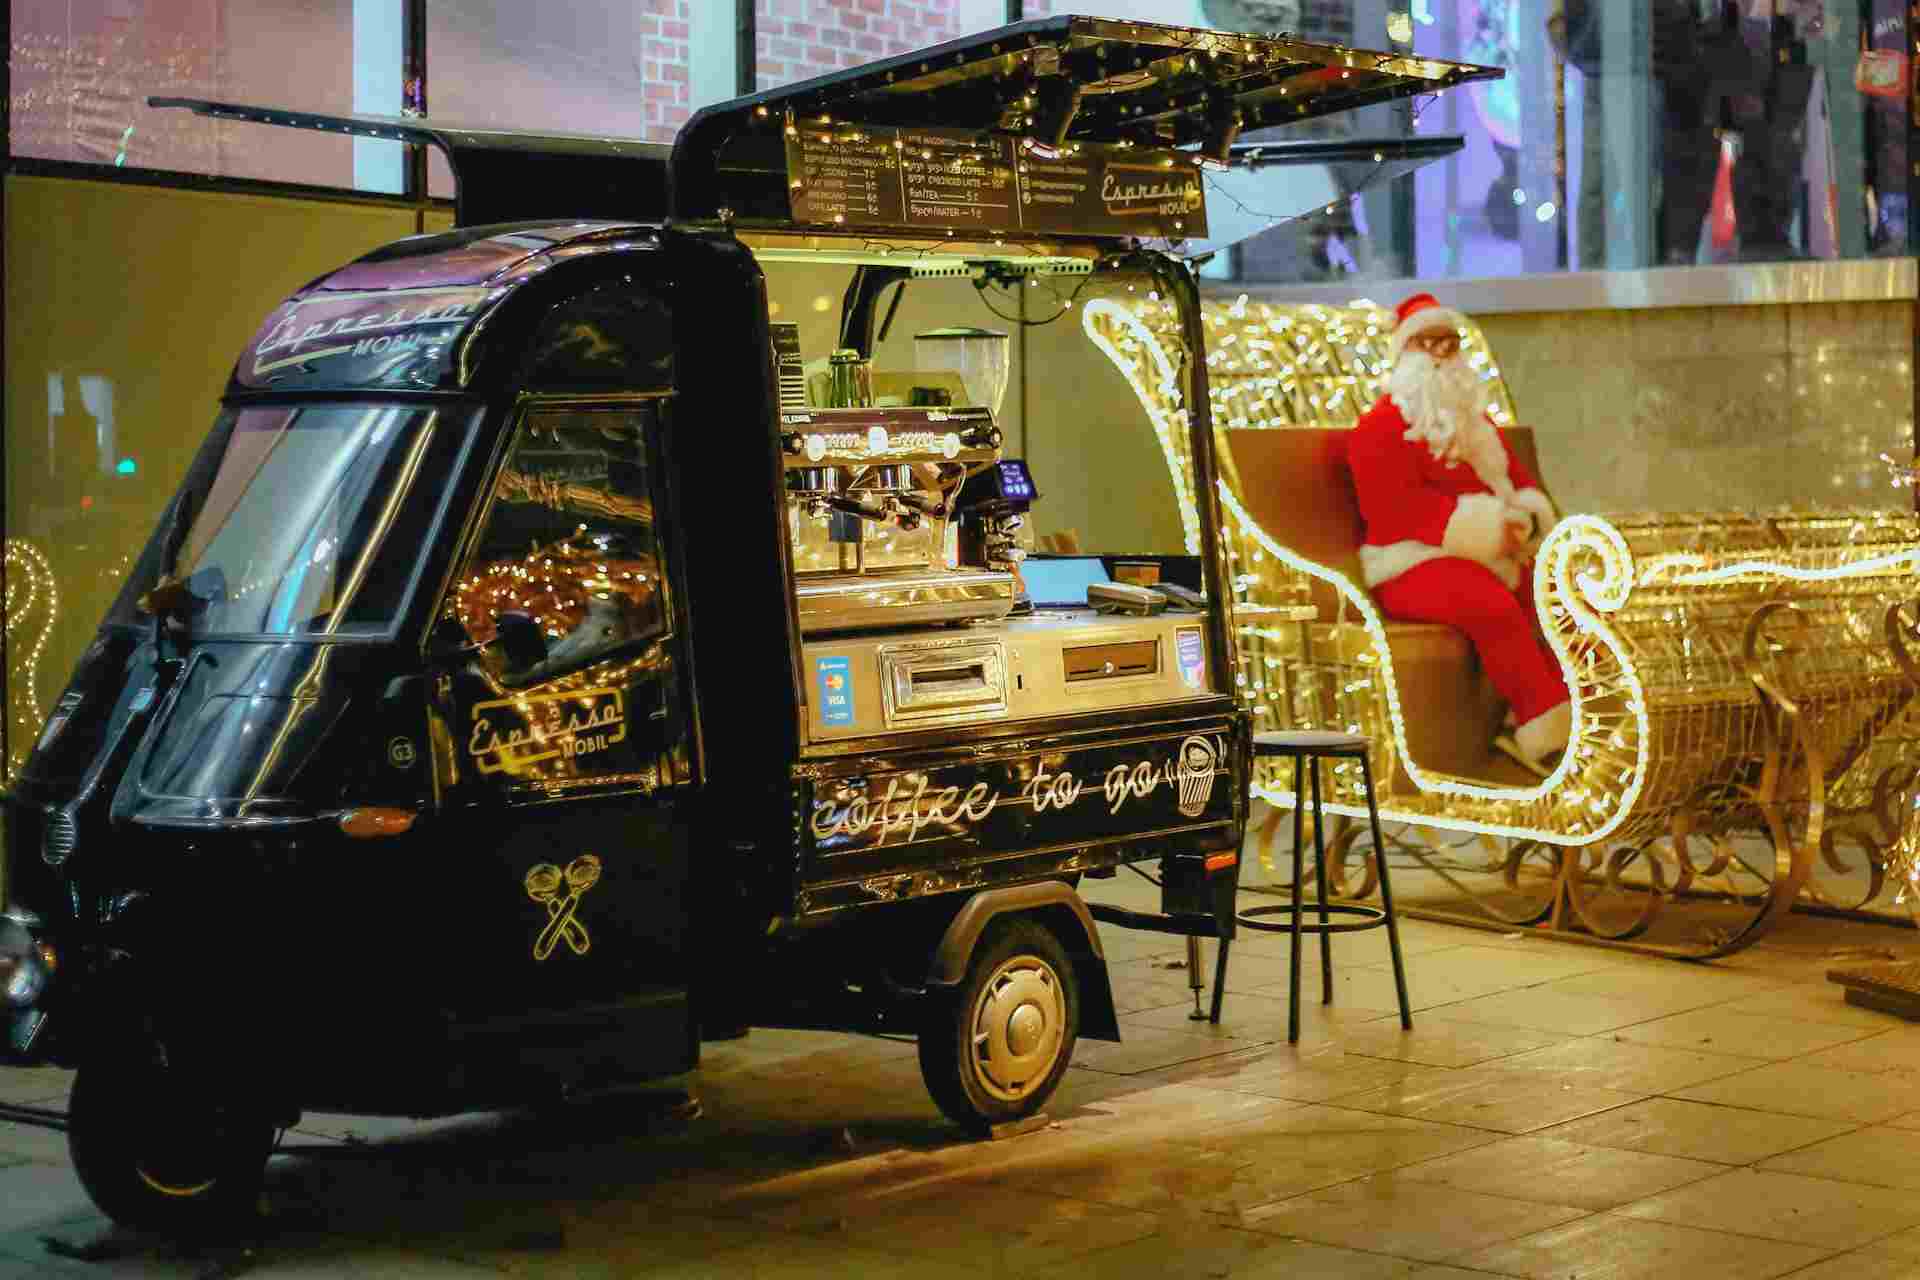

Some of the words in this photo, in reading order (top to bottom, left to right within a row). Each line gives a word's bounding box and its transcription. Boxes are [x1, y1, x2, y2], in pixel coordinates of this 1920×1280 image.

[1101, 174, 1196, 206] Espresso
[255, 304, 467, 355] Espresso
[469, 703, 622, 756] Espresso
[562, 735, 609, 758] MOBIL
[811, 775, 999, 846] coffee
[1026, 761, 1081, 812] to
[1105, 759, 1160, 815] go
